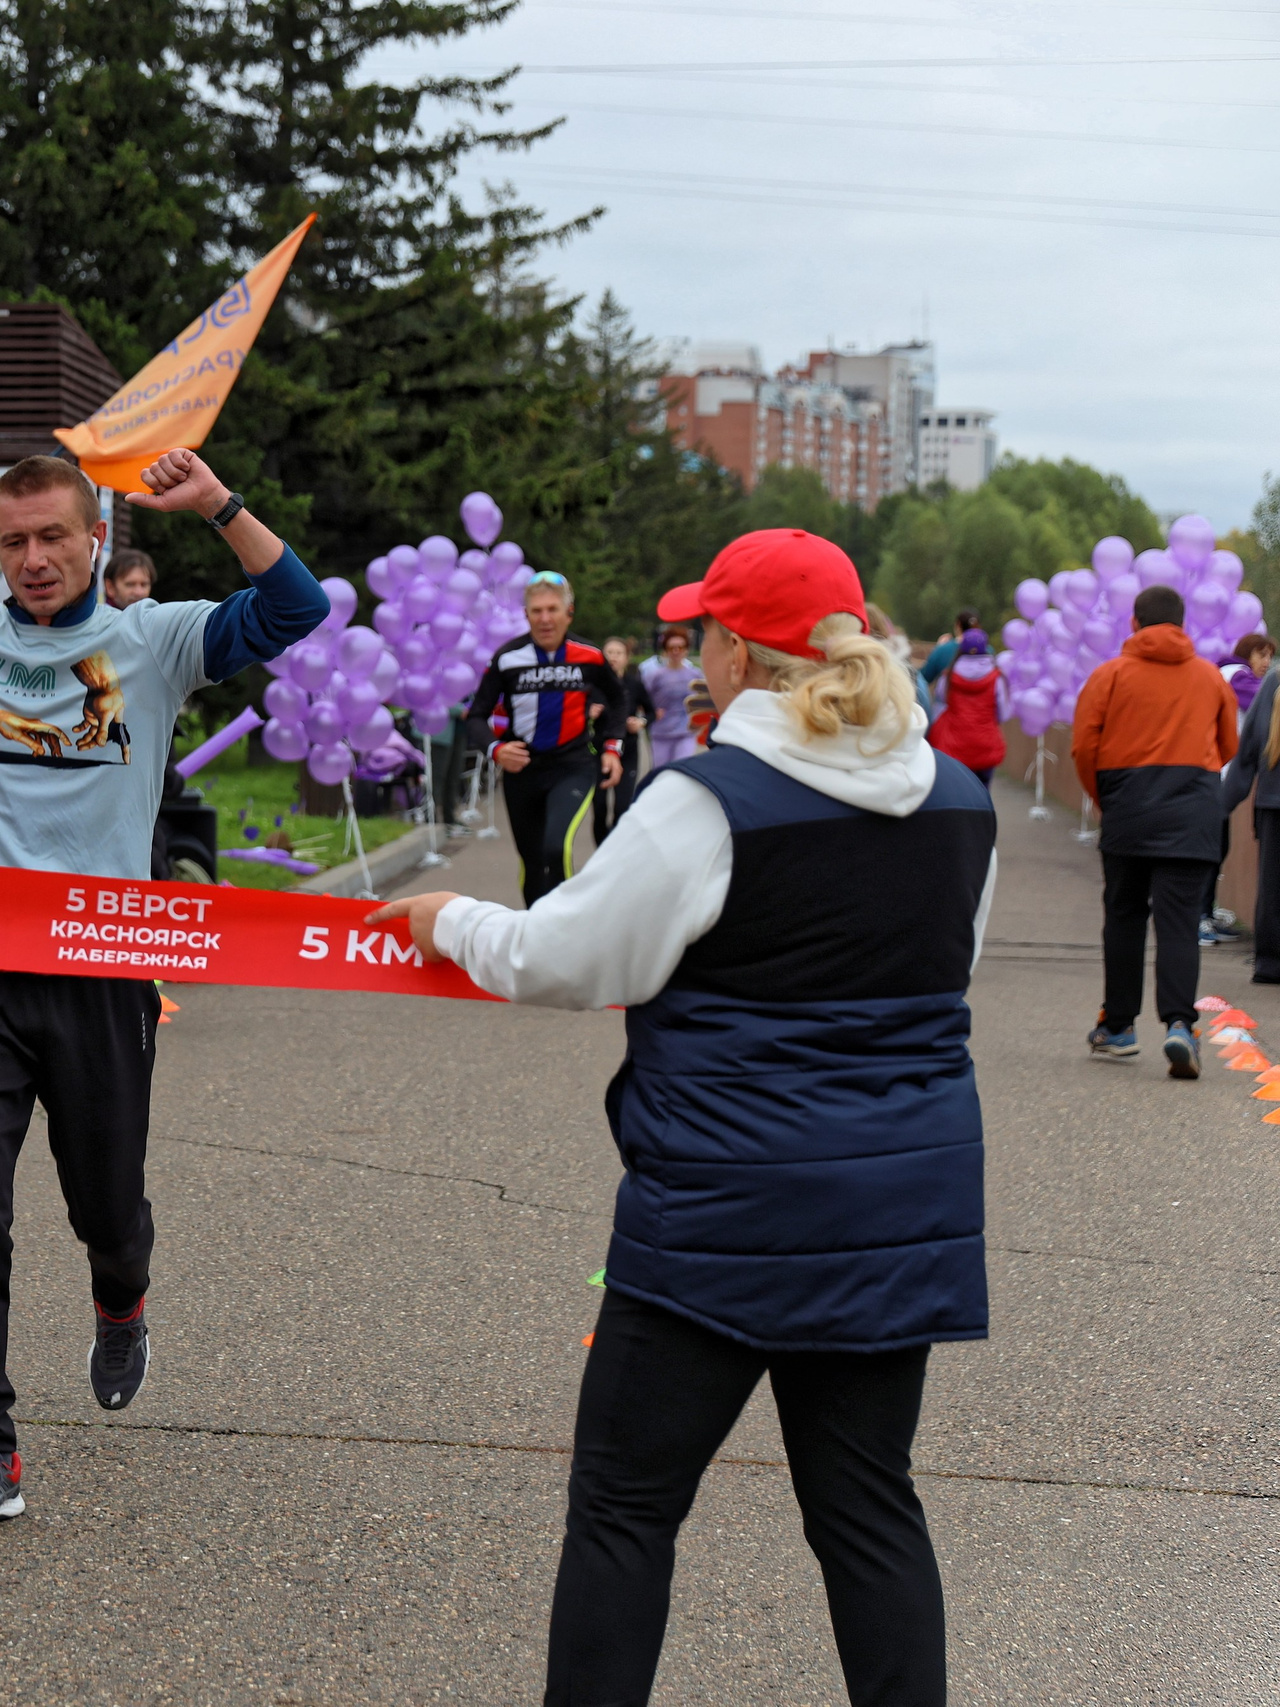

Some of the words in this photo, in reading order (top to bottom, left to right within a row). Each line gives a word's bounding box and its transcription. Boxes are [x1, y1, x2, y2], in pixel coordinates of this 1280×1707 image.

[65, 887, 87, 912] 5
[96, 887, 213, 923] ВЁРСТ
[49, 919, 221, 951] КРАСНОЯРСК
[298, 925, 329, 961] 5
[345, 928, 425, 968] КМ
[57, 945, 208, 970] НАБЕРЕЖНАЯ
